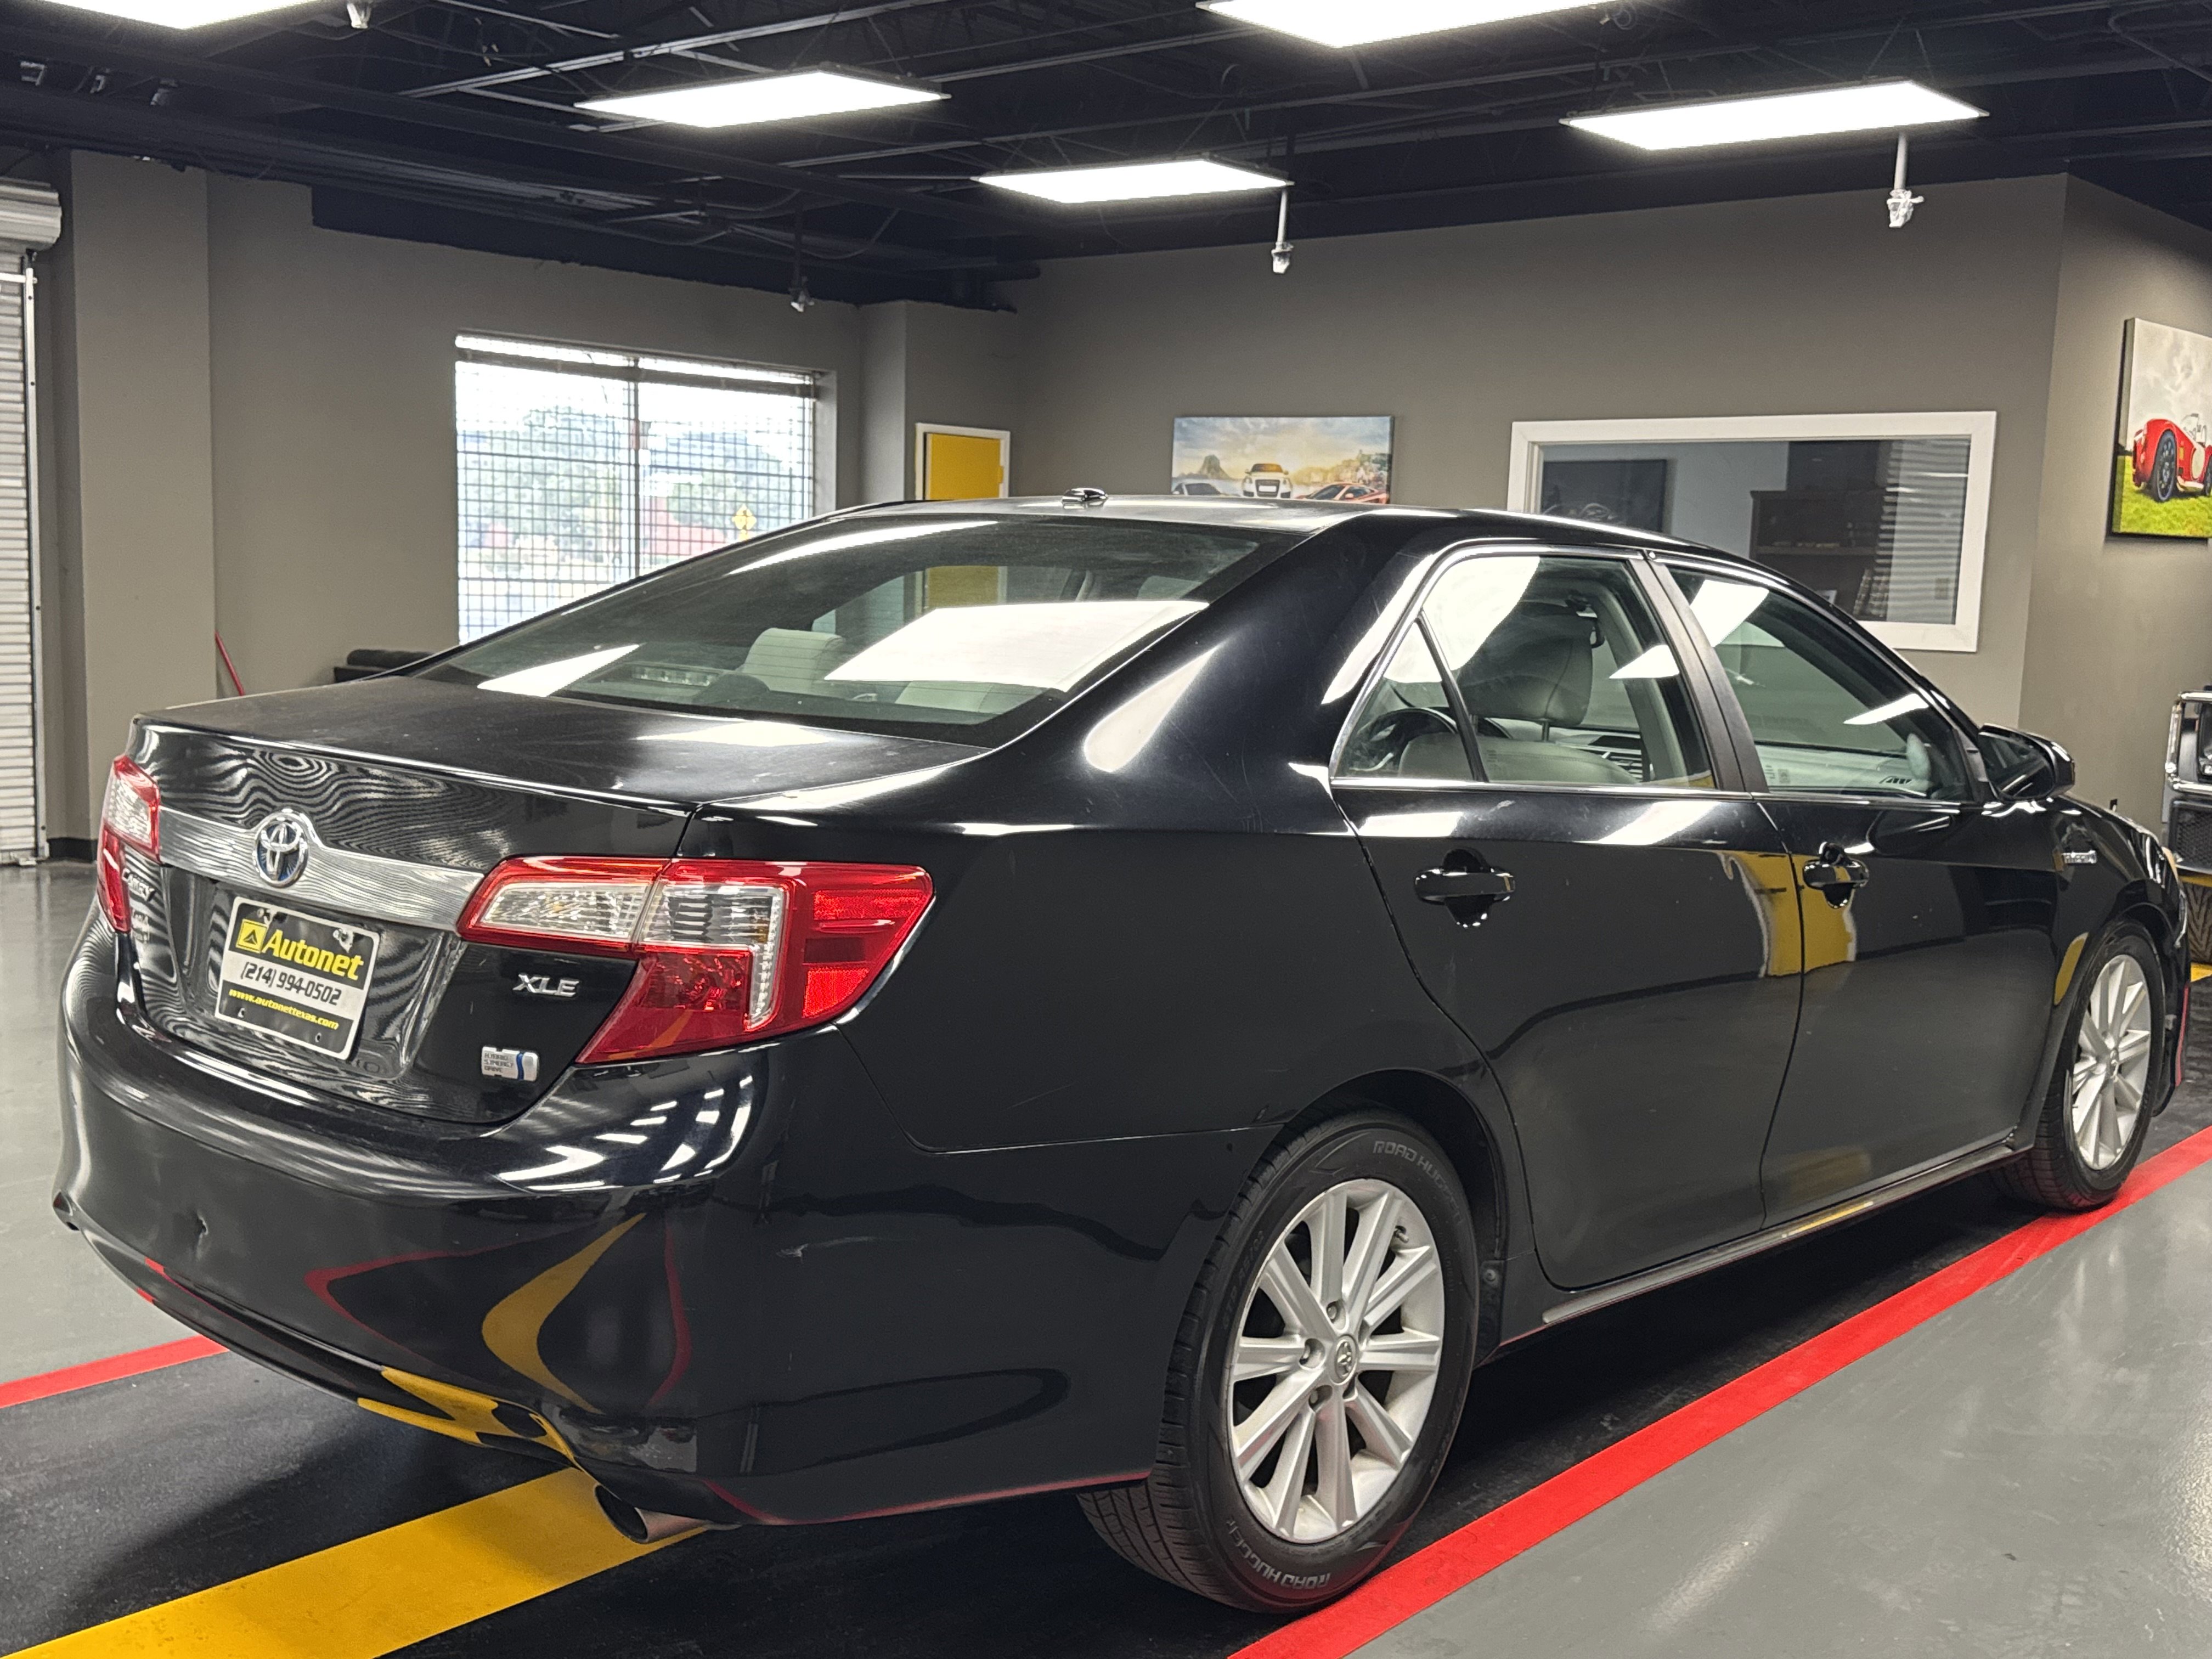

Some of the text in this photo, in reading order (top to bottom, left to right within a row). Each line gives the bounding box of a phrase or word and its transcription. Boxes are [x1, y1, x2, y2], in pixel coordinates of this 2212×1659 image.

[261, 929, 364, 980] Autonet
[241, 961, 342, 1006] (214) 994-0502
[512, 972, 580, 997] XLE
[228, 989, 339, 1030] www.autonettexas.com
[1373, 1141, 1418, 1162] ROAD
[1280, 1572, 1331, 1590] ROAD
